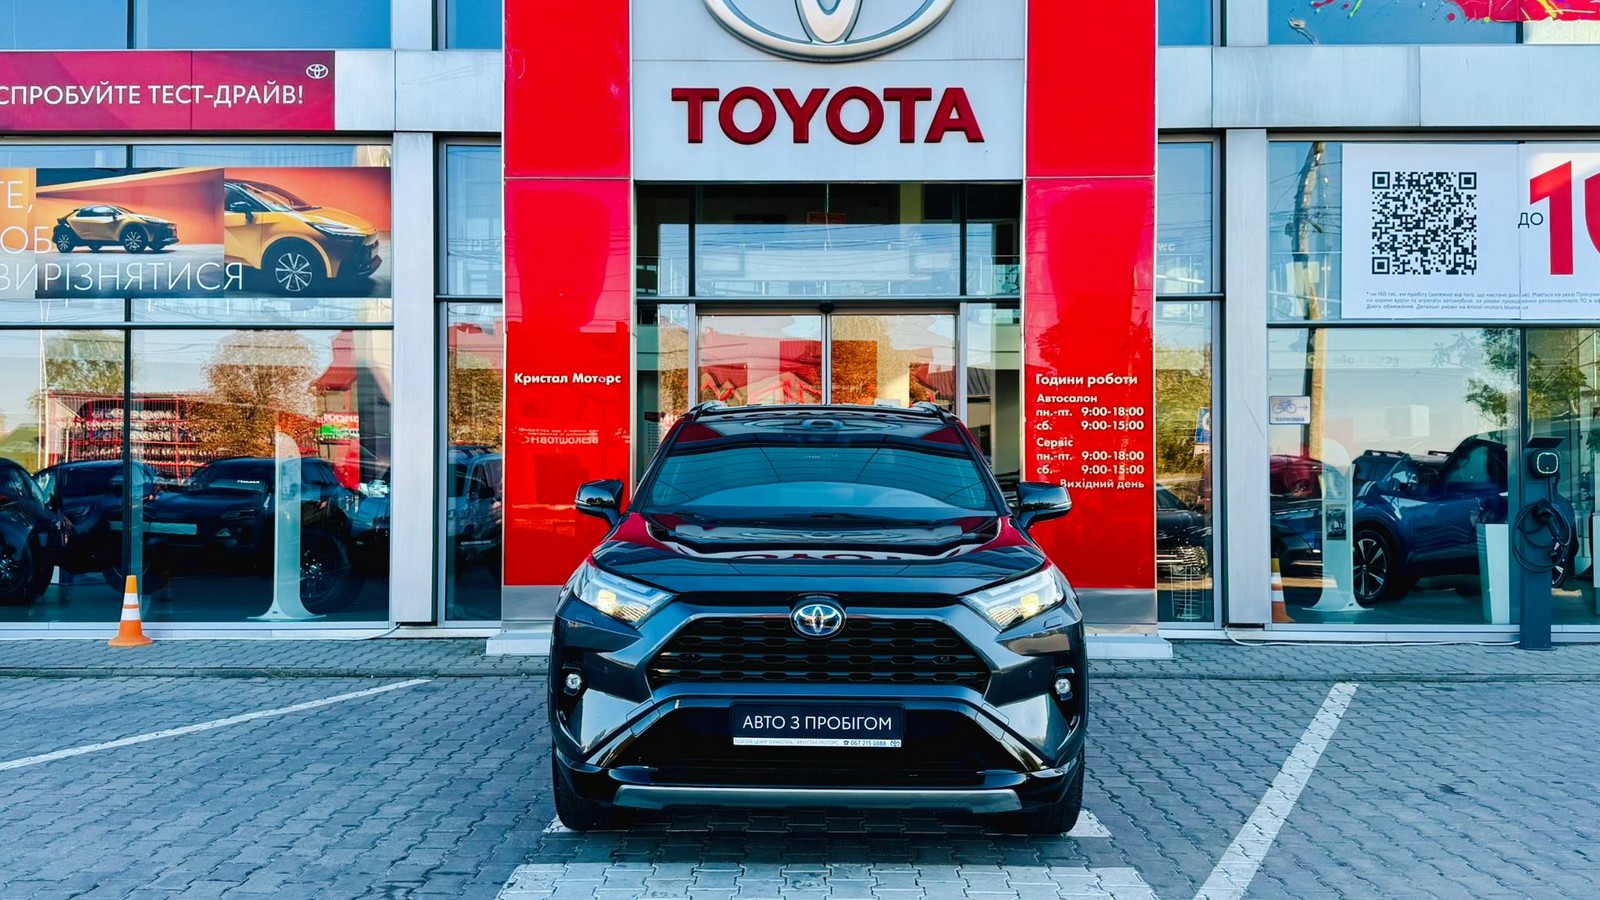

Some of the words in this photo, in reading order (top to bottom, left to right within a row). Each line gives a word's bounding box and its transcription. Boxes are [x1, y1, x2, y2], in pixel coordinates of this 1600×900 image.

[148, 80, 303, 108] ТЕСТ-ДРАЙВ!
[671, 86, 985, 145] TOYOTA
[0, 181, 33, 213] Е,
[1518, 212, 1544, 229] ДО
[514, 373, 568, 386] Кристал
[572, 373, 621, 386] Моторс
[1036, 374, 1084, 386] Години
[1087, 373, 1138, 388] роботи
[1037, 394, 1098, 403] Автосалон
[1036, 420, 1053, 430] сб.
[1036, 437, 1074, 449] Сервіс
[1036, 464, 1053, 474] сб.
[1117, 480, 1144, 489] день
[743, 716, 786, 729] АВТО
[805, 716, 892, 730] ПРОБІГОМ
